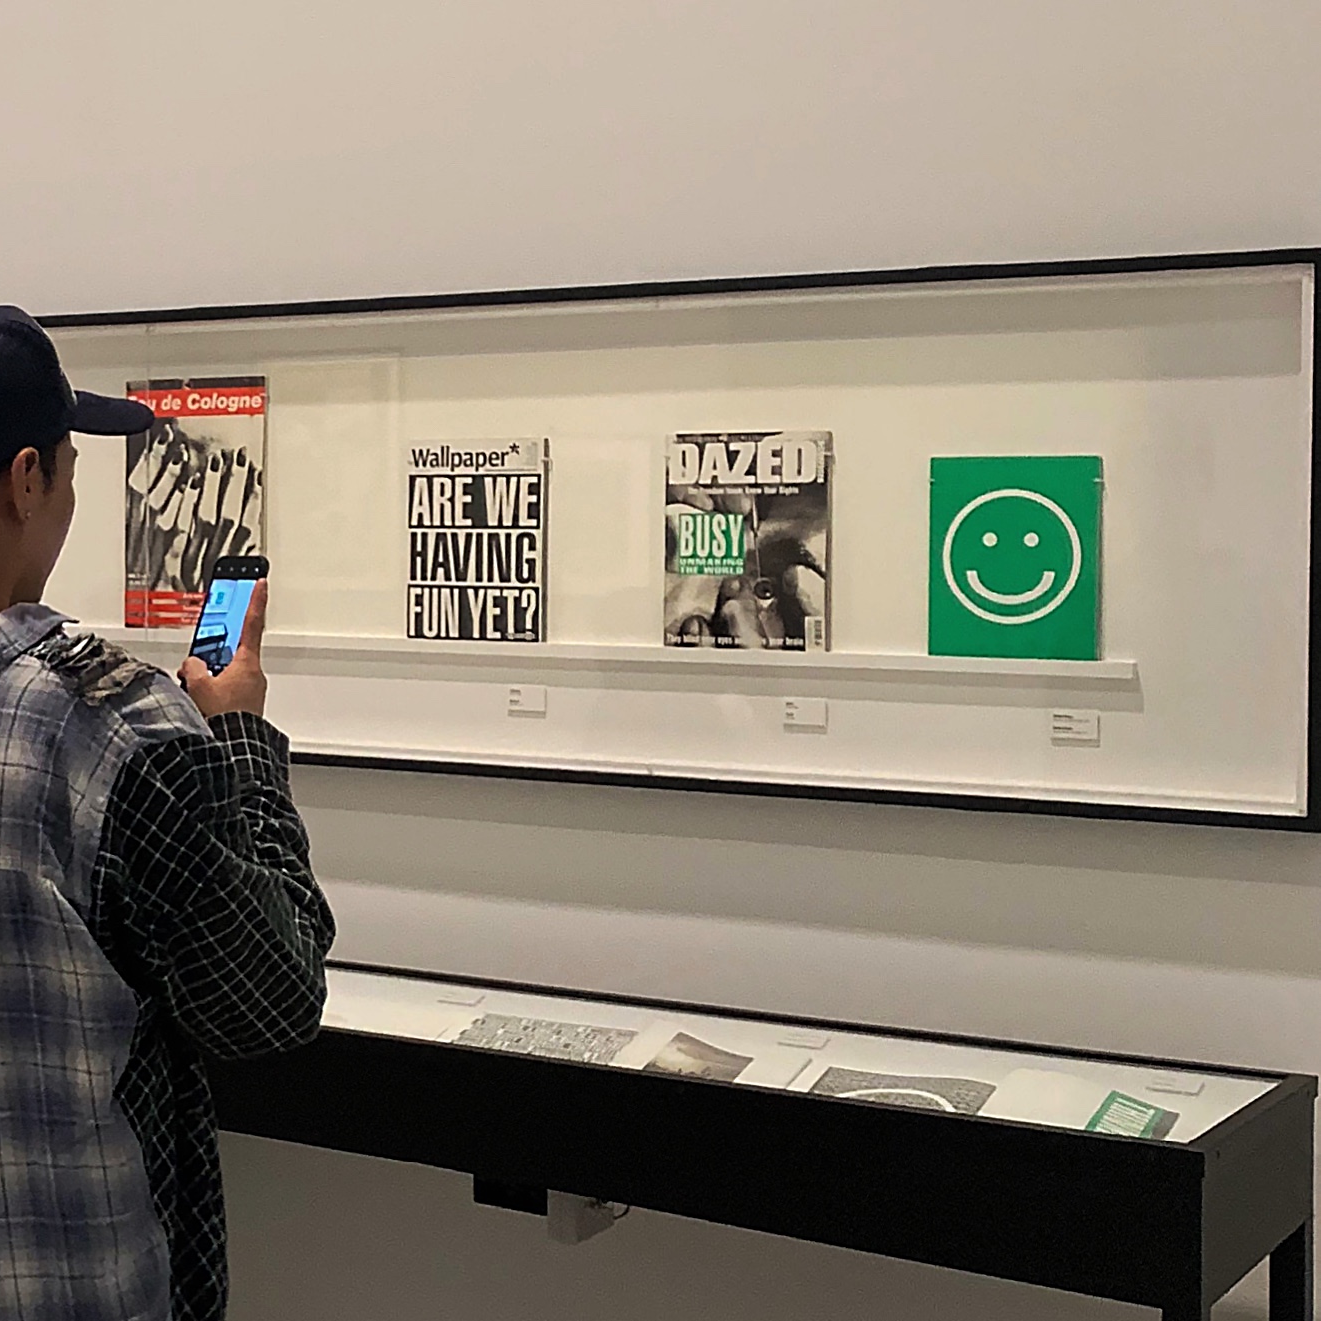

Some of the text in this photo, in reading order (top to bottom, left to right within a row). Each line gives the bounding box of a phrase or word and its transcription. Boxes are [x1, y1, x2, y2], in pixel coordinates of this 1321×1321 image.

[161, 395, 181, 410] de
[187, 393, 262, 412] Cologne
[668, 442, 816, 484] DAZED
[411, 476, 539, 527] ARE WE
[410, 532, 537, 583] HAVING
[680, 514, 744, 557] BUSY
[409, 587, 537, 640] FUN YET?
